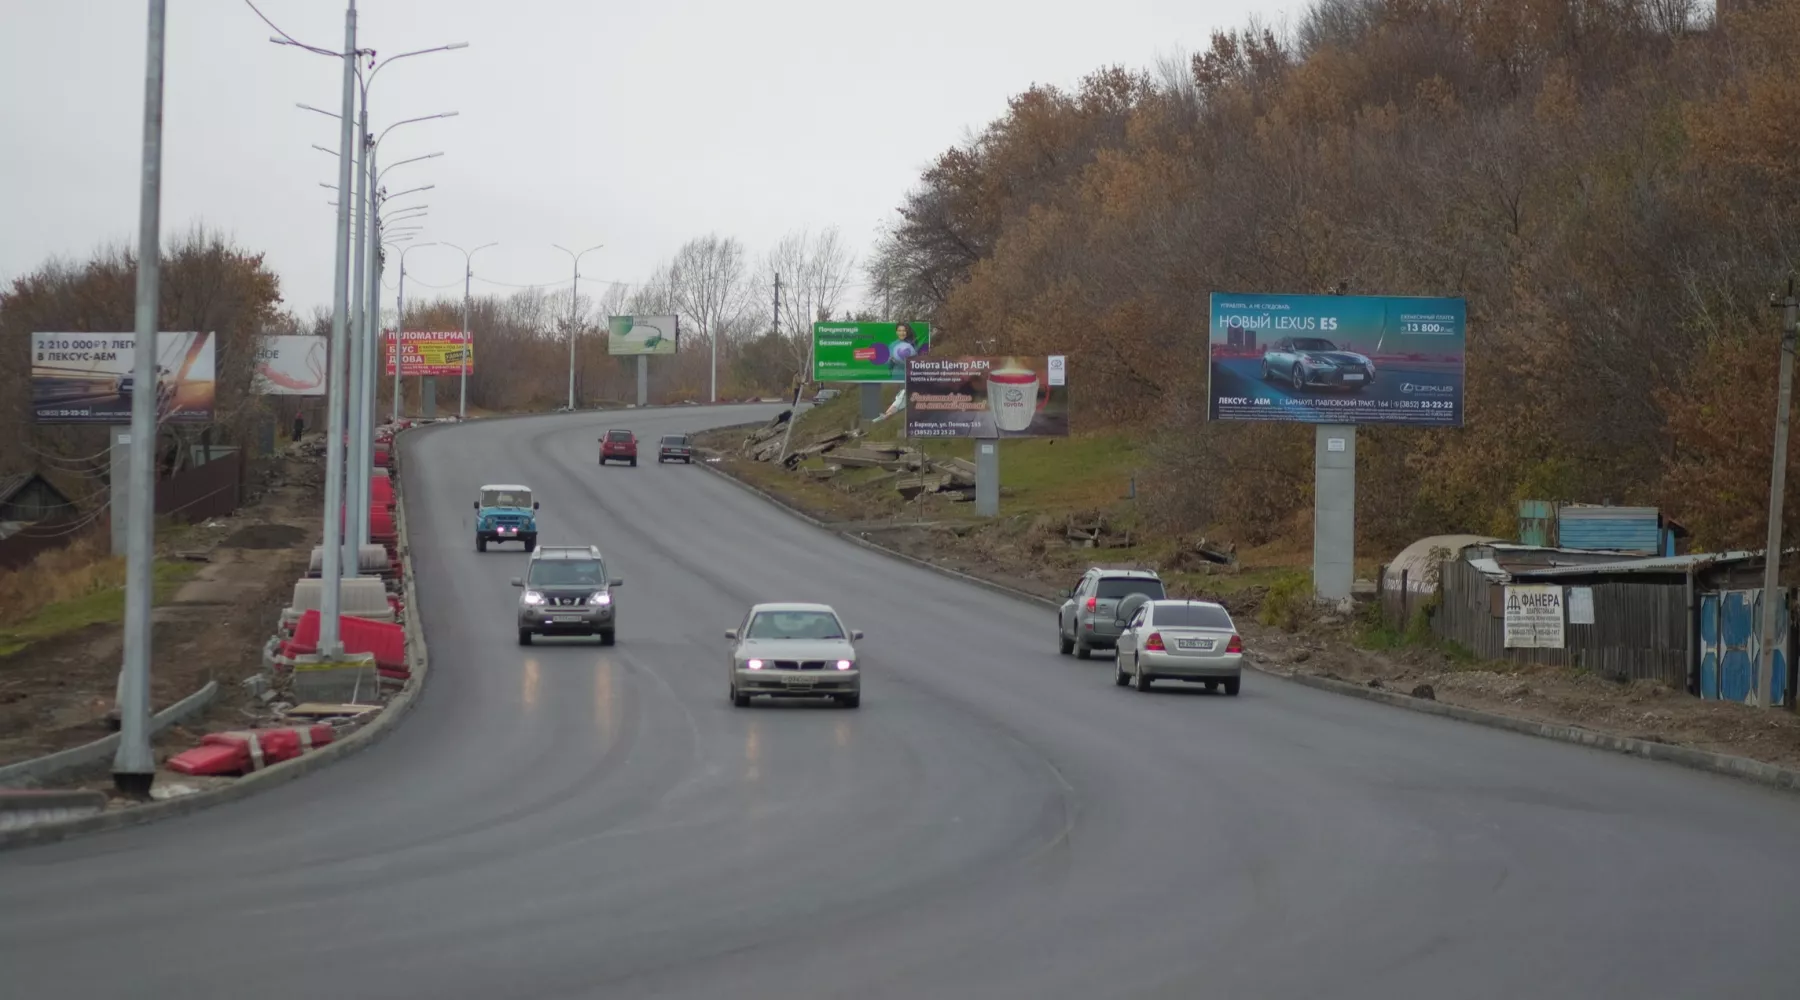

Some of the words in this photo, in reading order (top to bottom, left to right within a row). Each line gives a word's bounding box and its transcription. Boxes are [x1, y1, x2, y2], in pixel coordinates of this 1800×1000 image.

[1219, 313, 1271, 328] НОВЫЙ
[1275, 316, 1315, 330] LEXUS
[1320, 317, 1338, 330] ES
[1407, 324, 1418, 332] 13
[1422, 324, 1440, 332] 800
[38, 341, 44, 350] 2
[49, 341, 68, 349] 210
[38, 352, 44, 360] В
[48, 352, 117, 361] ЛЕКСУС-АЕМ
[388, 356, 423, 364] ДОВА
[910, 361, 940, 369] Тойота
[942, 361, 969, 370] Центр
[970, 361, 990, 369] АЕМ
[1218, 397, 1248, 405] ЛЕКСУС
[1286, 398, 1314, 406] БАРНАУЛ,
[1315, 398, 1356, 407] ПАВЛОВСКИЙ
[1358, 400, 1376, 408] ТРАКТ,
[1400, 400, 1420, 408] (3852)
[1421, 400, 1453, 408] 23-22-22
[1522, 593, 1560, 607] ФАНЕРА
